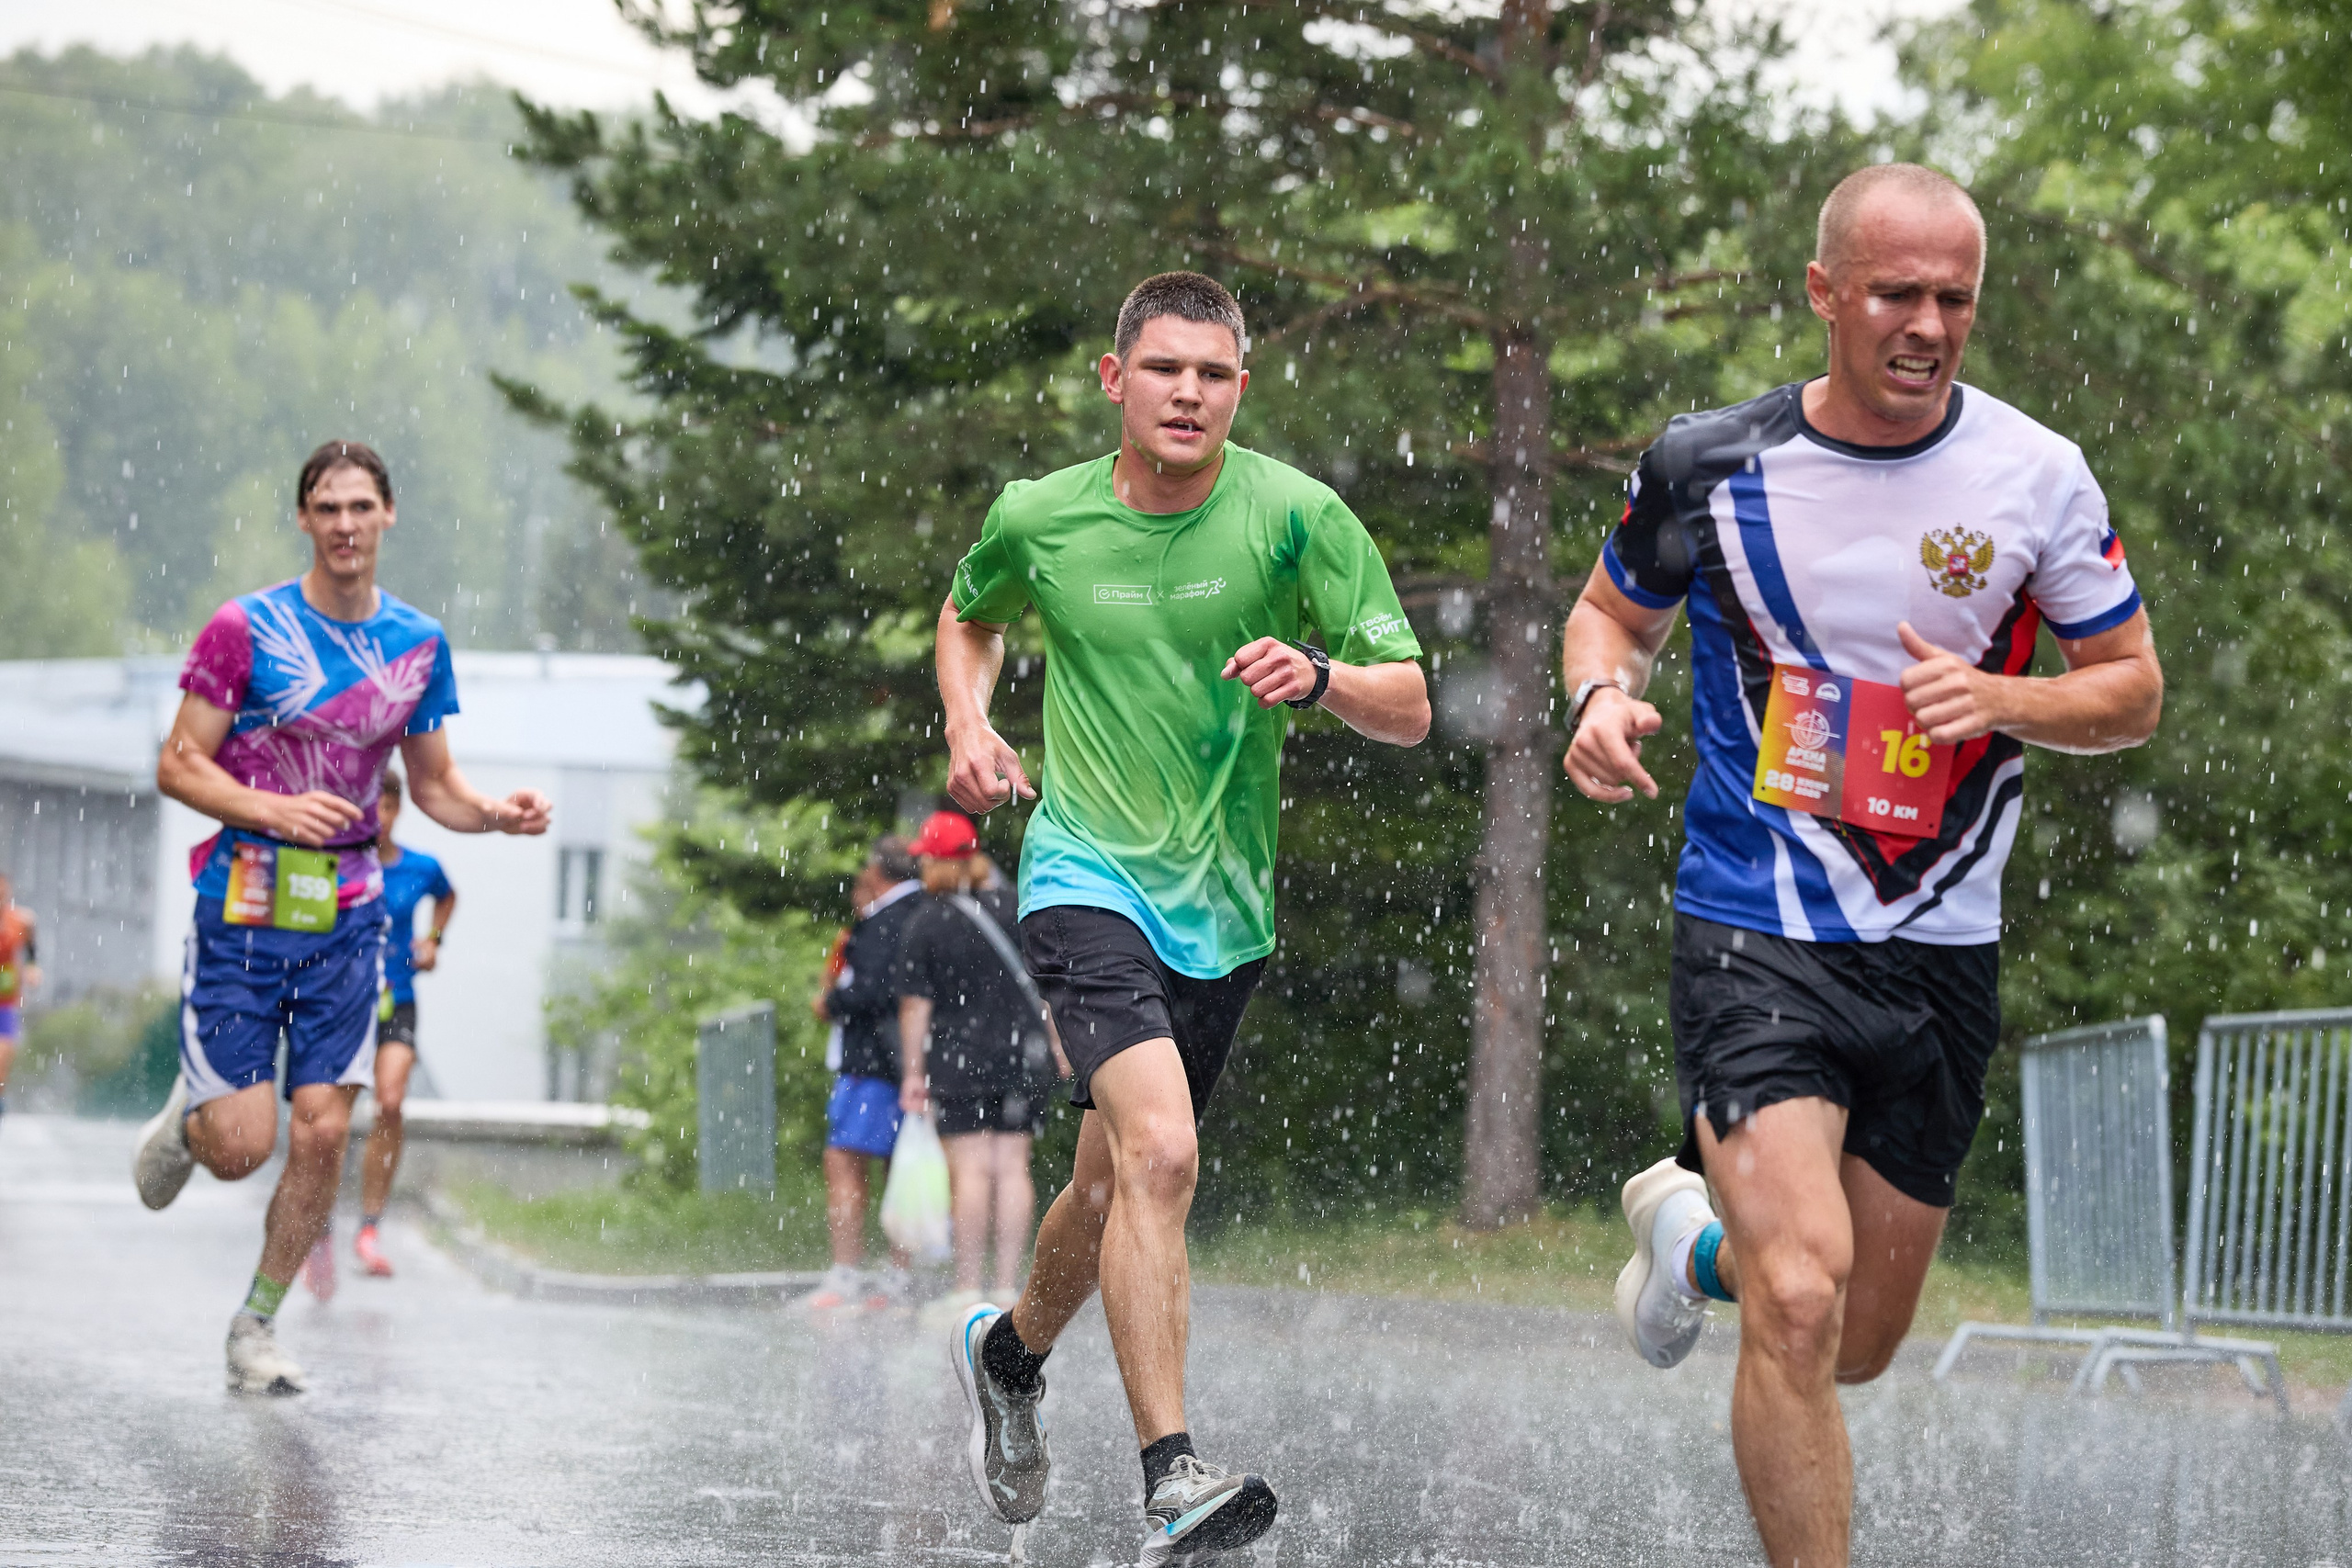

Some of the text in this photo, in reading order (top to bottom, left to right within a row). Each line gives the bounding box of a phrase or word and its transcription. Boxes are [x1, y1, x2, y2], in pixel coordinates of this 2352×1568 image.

[1112, 590, 1144, 599] Прайм
[1170, 590, 1205, 601] марафон
[1173, 581, 1208, 592] зелёный
[1881, 729, 1931, 778] 16
[1765, 769, 1795, 792] 28
[1867, 796, 1891, 816] 10
[288, 873, 331, 902] 159
